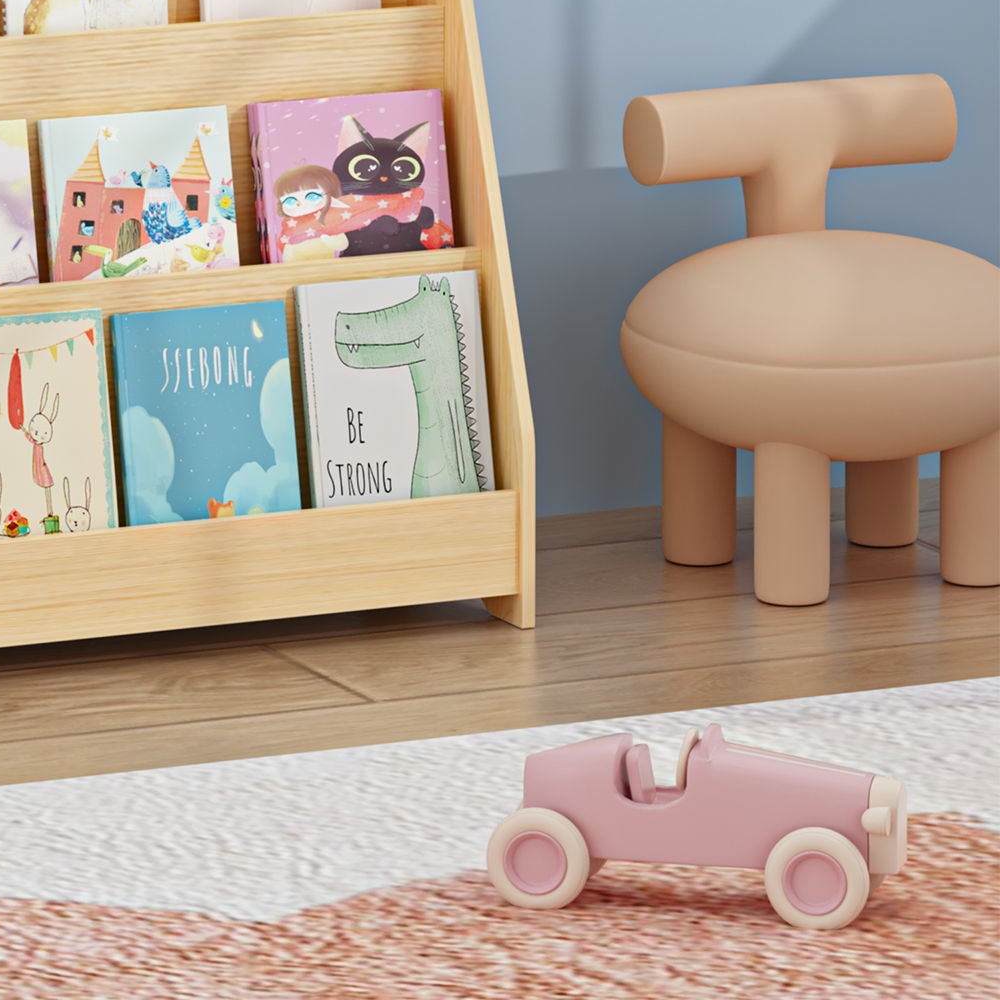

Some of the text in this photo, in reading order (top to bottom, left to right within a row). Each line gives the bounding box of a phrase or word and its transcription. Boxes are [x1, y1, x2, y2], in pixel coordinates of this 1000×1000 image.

[161, 345, 253, 393] SSEBONG
[346, 407, 366, 444] BE
[326, 459, 393, 499] STRONG
